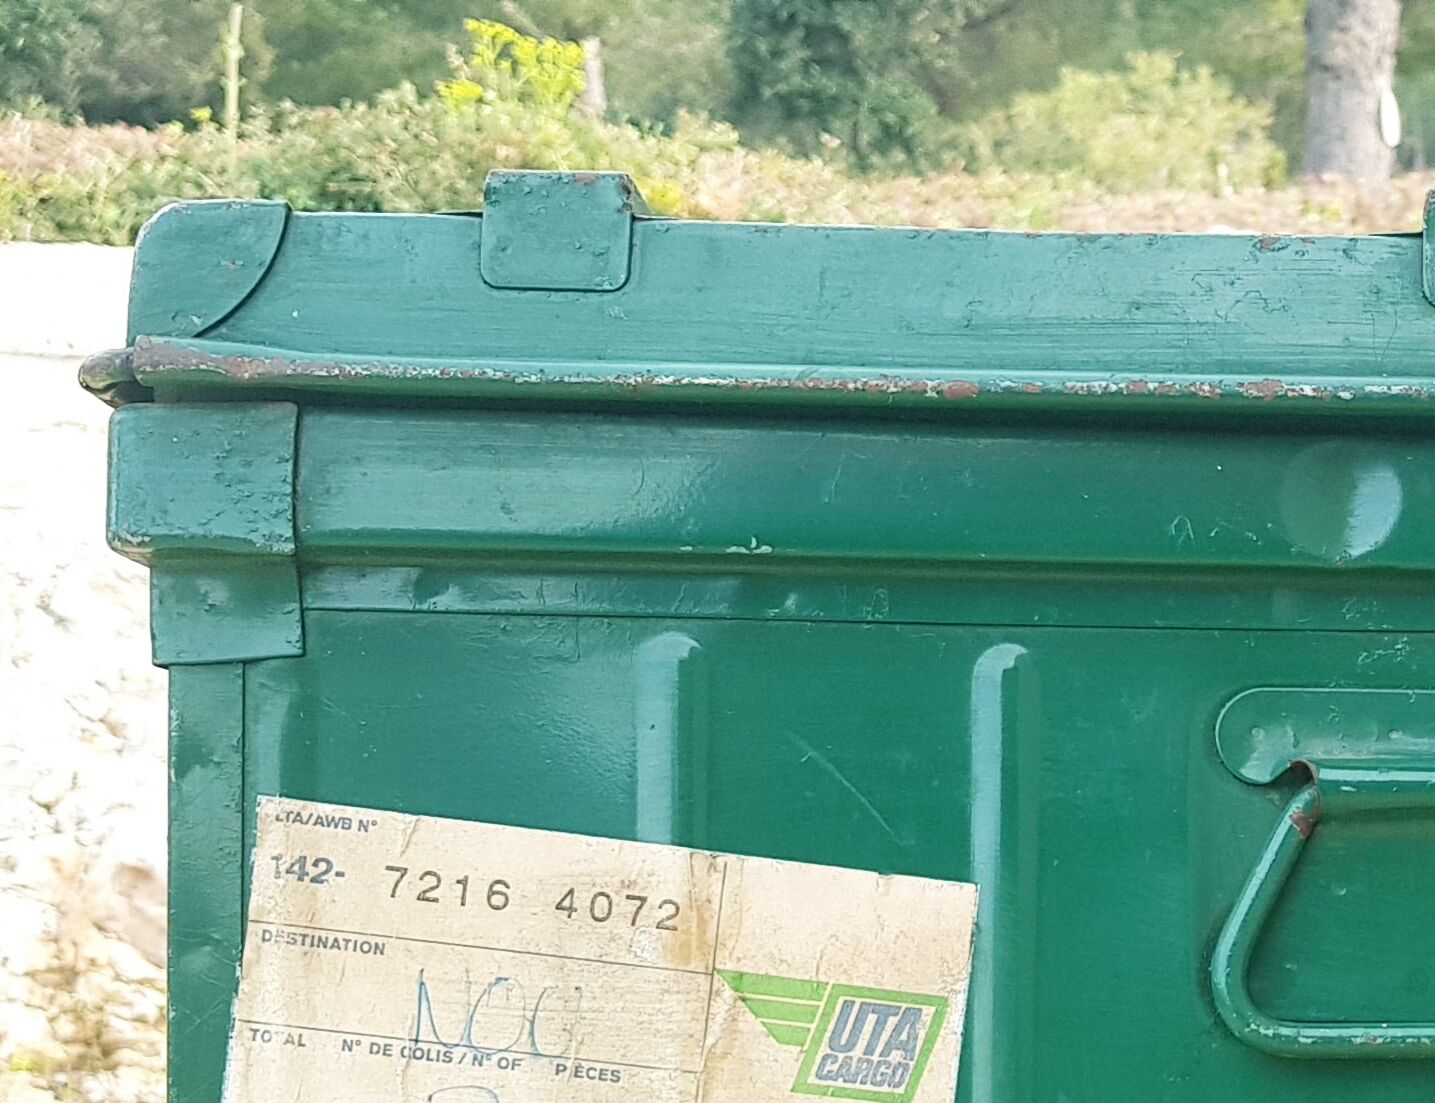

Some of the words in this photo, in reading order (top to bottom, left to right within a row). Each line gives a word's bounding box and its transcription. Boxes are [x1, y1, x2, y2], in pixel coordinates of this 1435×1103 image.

[384, 864, 512, 911] 7216
[554, 887, 681, 931] 4072
[341, 1038, 362, 1052] N°
[369, 1041, 394, 1057] DE
[400, 1045, 454, 1064] COLIS
[496, 1056, 525, 1071] OF
[828, 1000, 923, 1061] UTA
[815, 1053, 911, 1089] CARGO
